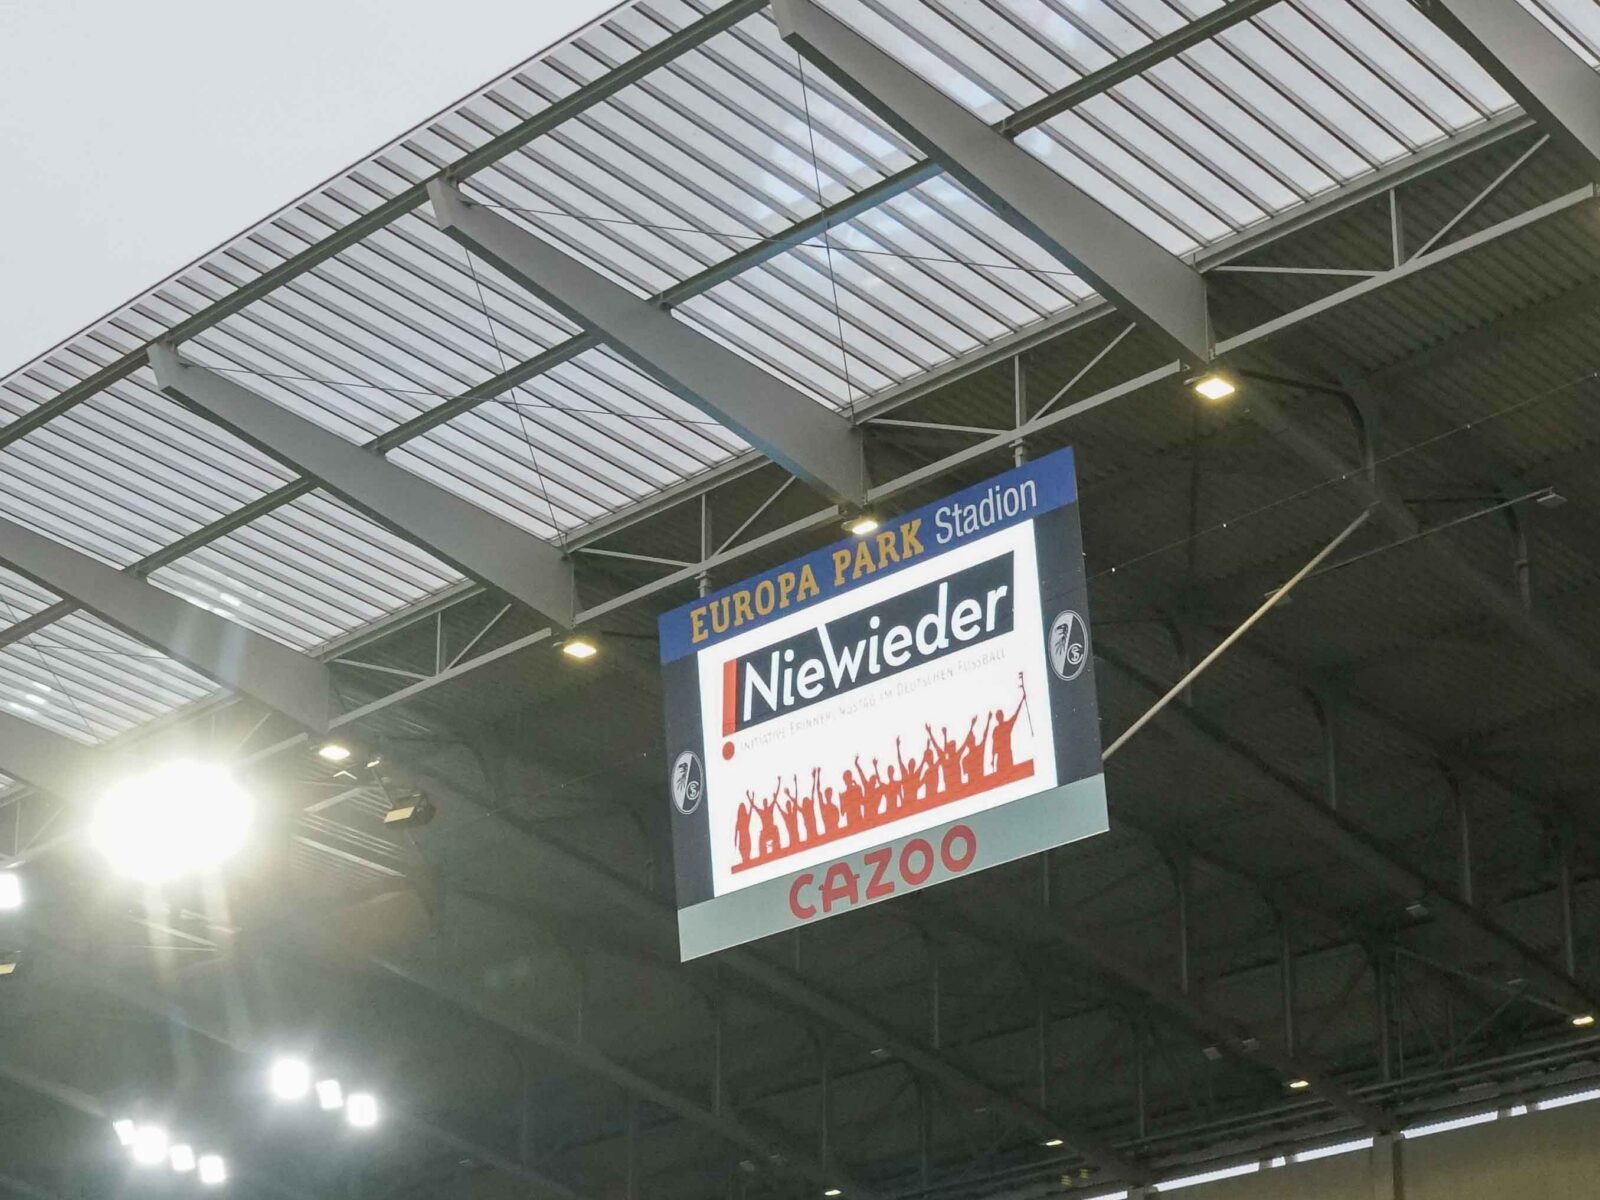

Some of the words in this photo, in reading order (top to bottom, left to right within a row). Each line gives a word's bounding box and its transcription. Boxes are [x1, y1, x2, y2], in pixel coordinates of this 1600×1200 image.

[690, 563, 820, 644] EUROPA
[833, 517, 925, 587] PARK
[935, 479, 1038, 544] Stadion
[789, 824, 977, 919] CAZOO
